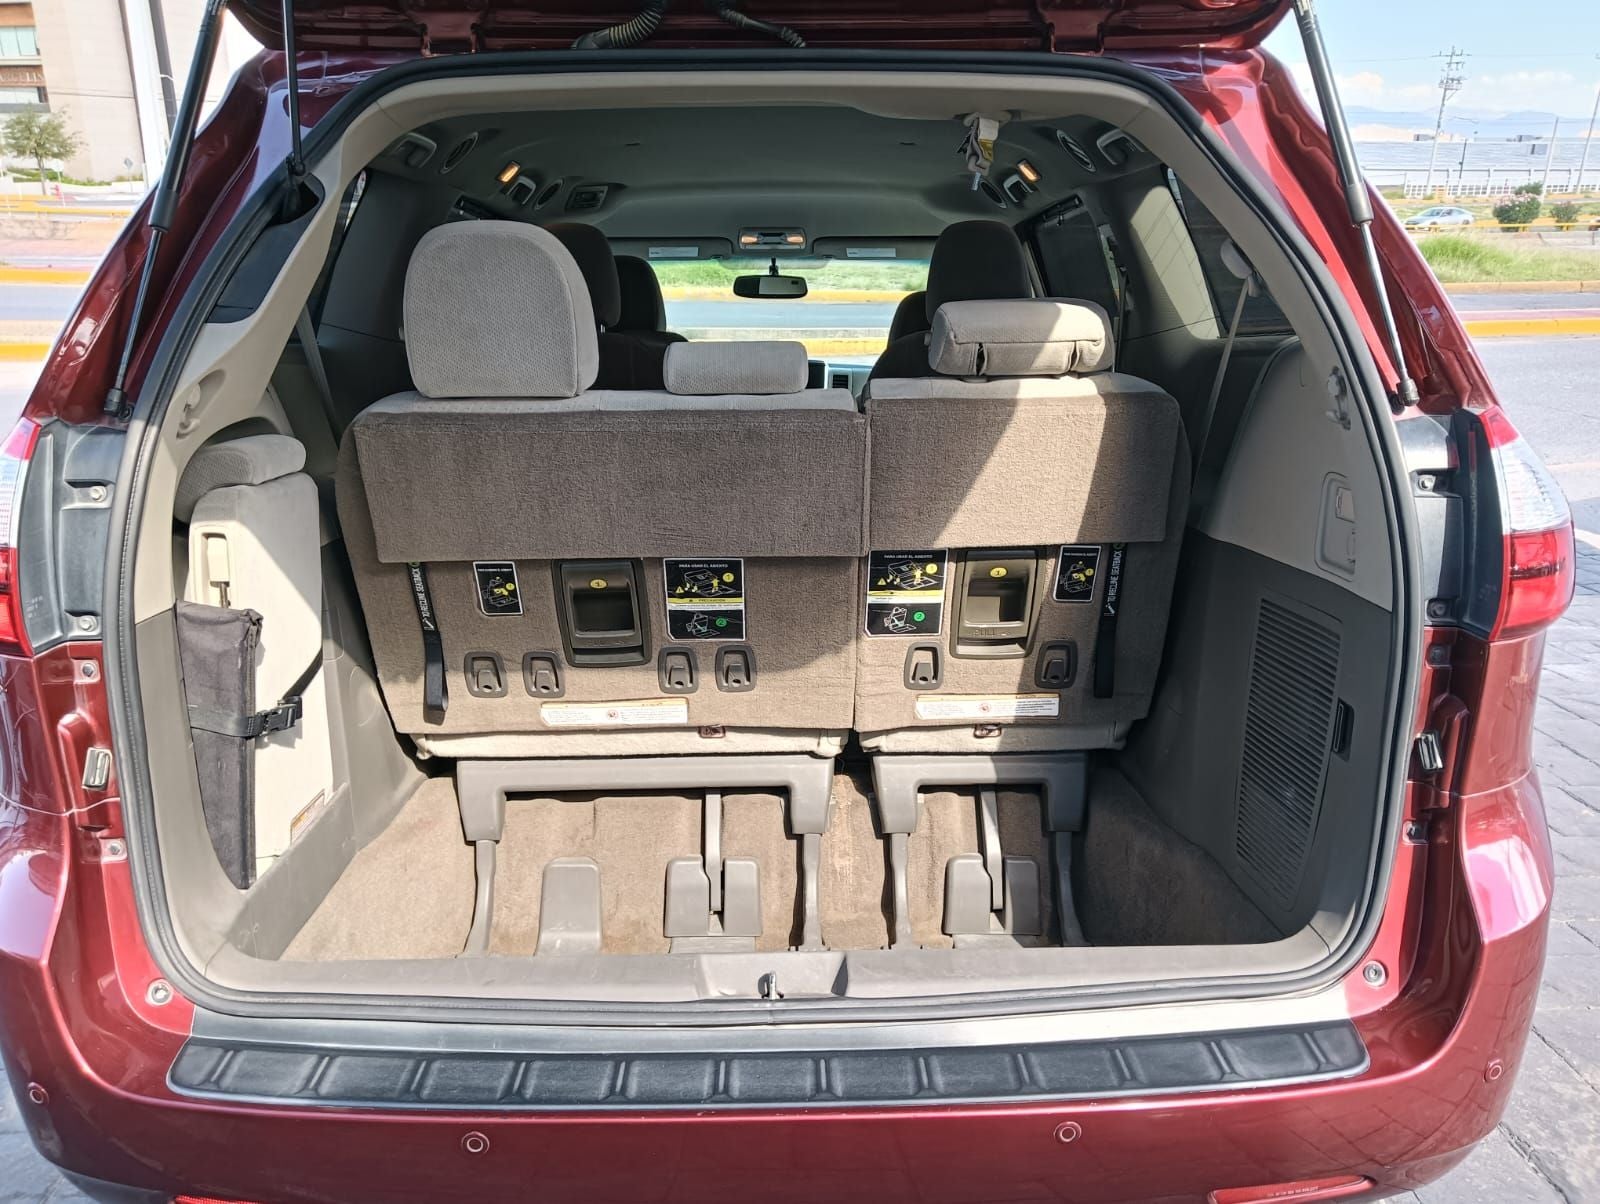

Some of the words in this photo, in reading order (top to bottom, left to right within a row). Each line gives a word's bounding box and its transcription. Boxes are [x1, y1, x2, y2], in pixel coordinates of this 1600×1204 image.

[1111, 550, 1122, 575] SEATBACK
[412, 568, 424, 592] SEATBACK
[1109, 575, 1119, 595] RECLINE
[417, 592, 429, 611] RECLINE
